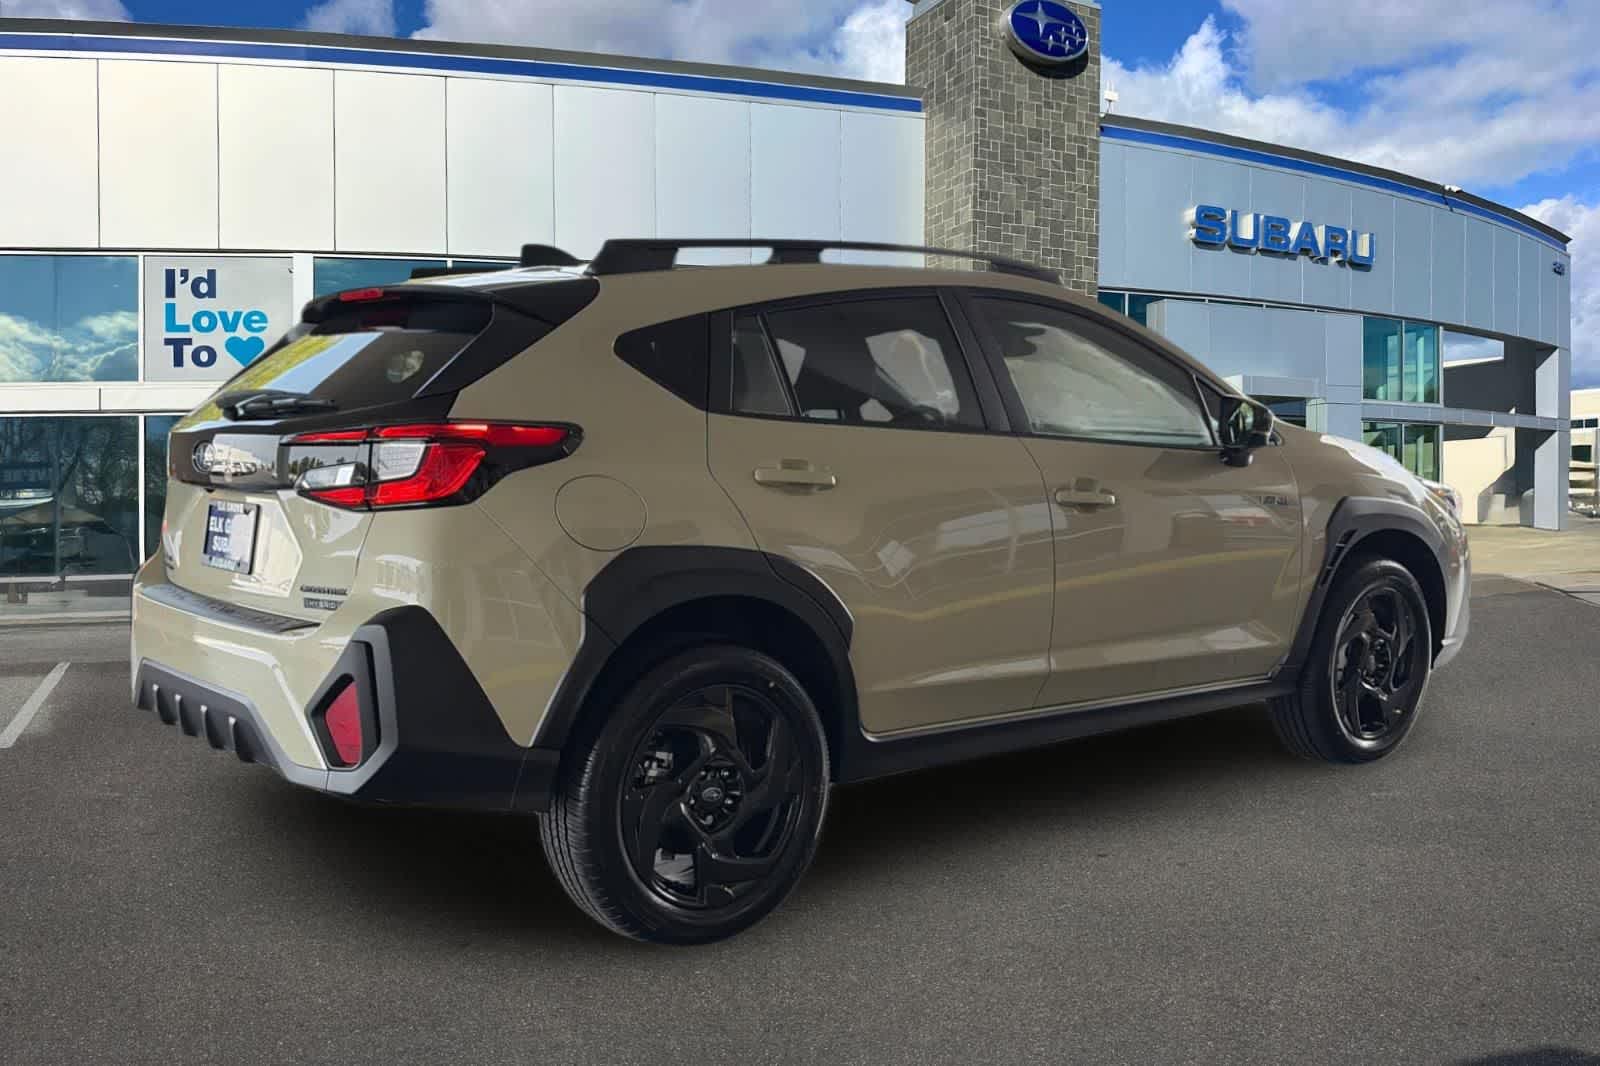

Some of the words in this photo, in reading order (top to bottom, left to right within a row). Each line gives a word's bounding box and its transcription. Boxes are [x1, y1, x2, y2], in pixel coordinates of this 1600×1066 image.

[1194, 204, 1376, 265] SUBARU
[164, 268, 217, 299] I’d
[164, 302, 269, 333] Love
[163, 337, 218, 368] To
